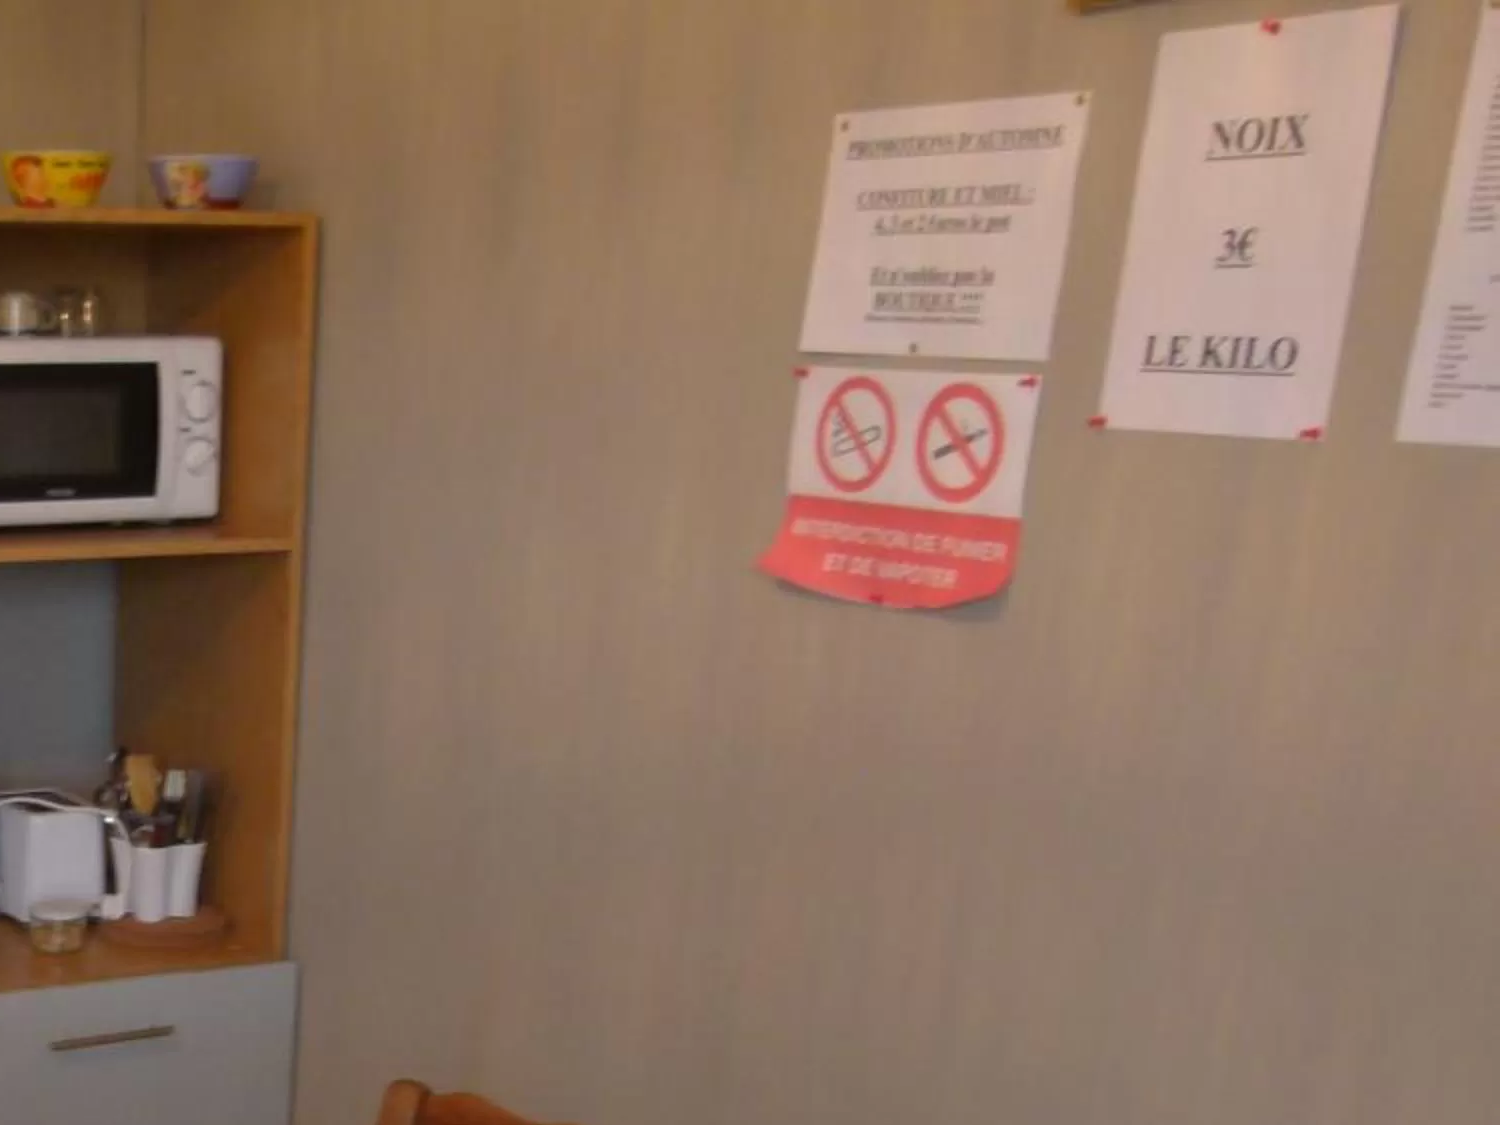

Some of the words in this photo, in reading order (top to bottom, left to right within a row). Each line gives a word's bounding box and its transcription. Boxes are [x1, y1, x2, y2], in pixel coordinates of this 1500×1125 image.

[1205, 114, 1309, 157] NOIX
[1215, 226, 1259, 267] 3€
[1141, 335, 1190, 371] LE
[1199, 336, 1299, 374] KILO
